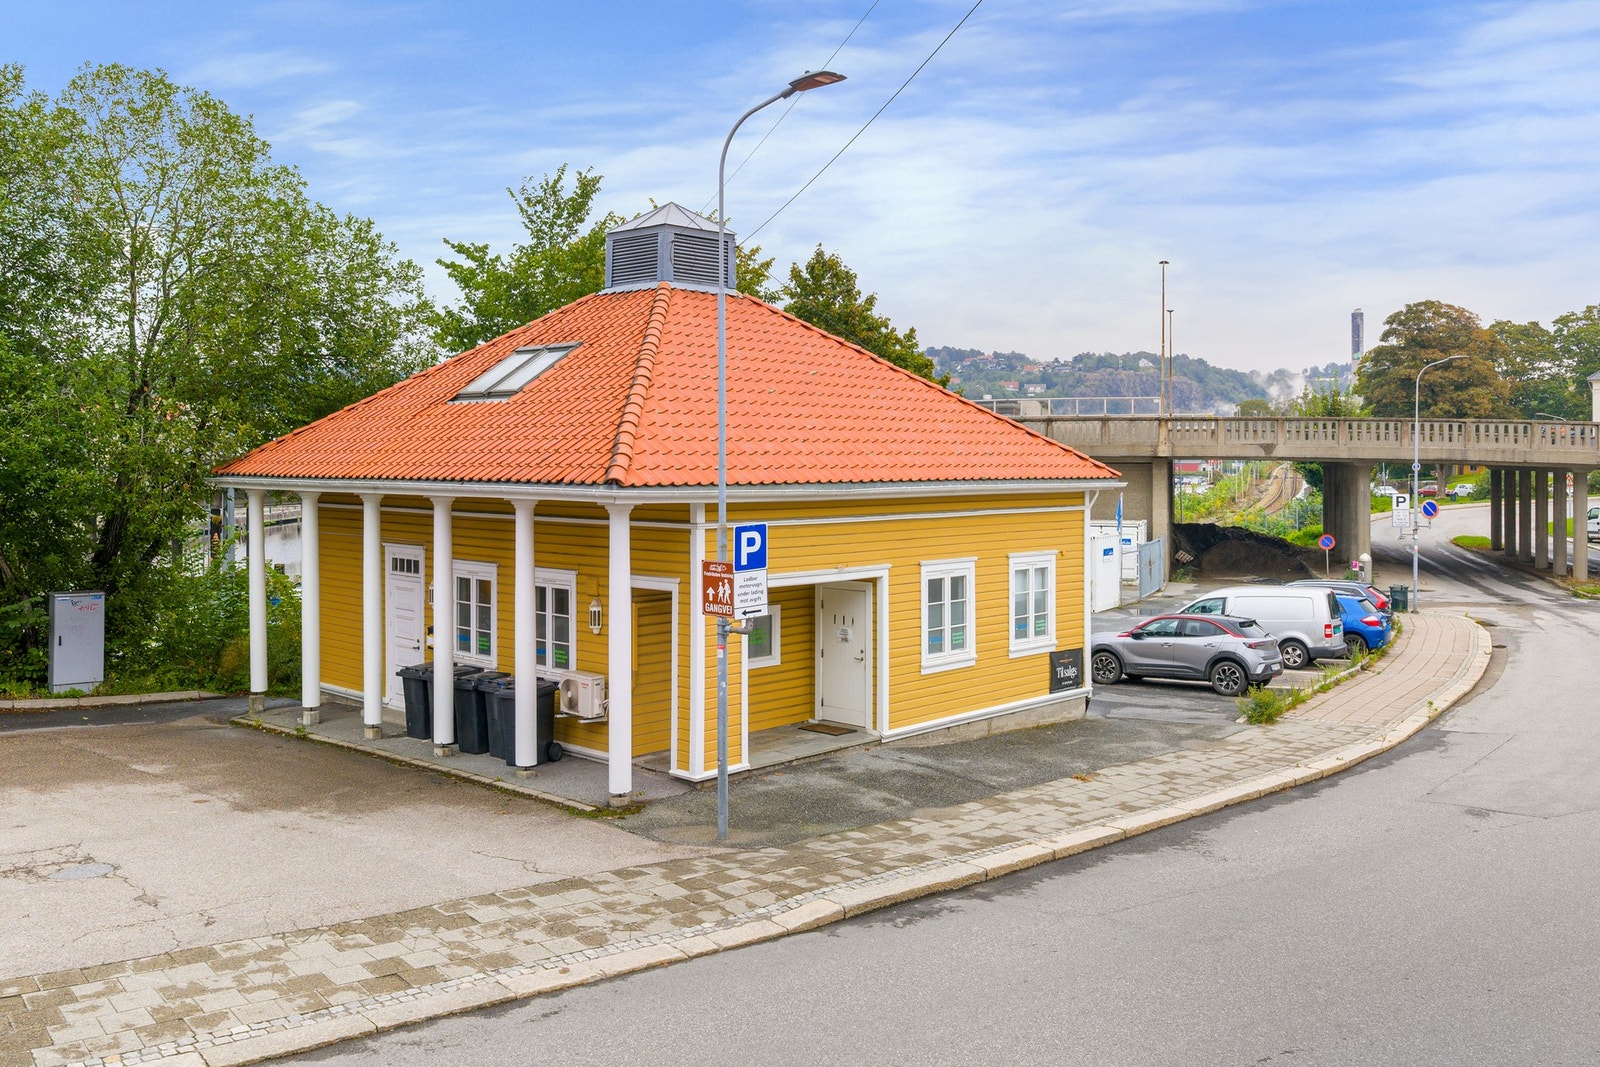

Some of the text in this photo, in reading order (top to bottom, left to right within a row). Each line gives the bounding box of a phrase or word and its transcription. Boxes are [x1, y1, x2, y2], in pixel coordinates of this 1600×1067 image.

[1396, 496, 1406, 507] P
[741, 531, 761, 566] P
[705, 603, 732, 614] GANGVEI
